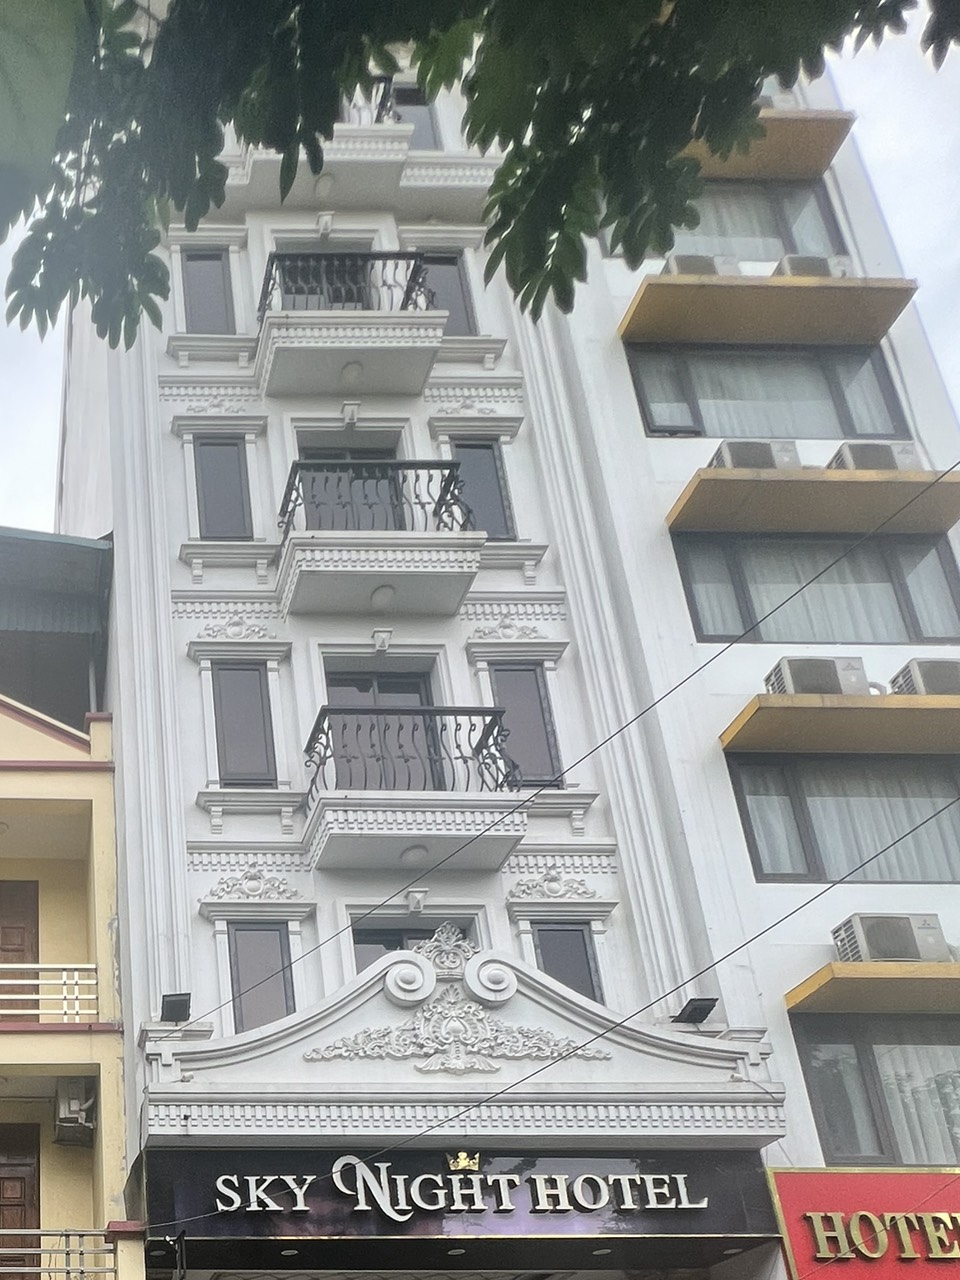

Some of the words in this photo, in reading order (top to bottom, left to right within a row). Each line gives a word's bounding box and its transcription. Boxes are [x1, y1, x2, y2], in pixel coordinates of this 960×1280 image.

[215, 1174, 317, 1212] SKY
[331, 1154, 521, 1222] NIGHT
[530, 1174, 709, 1211] HOTEL
[805, 1210, 960, 1259] HOTE
